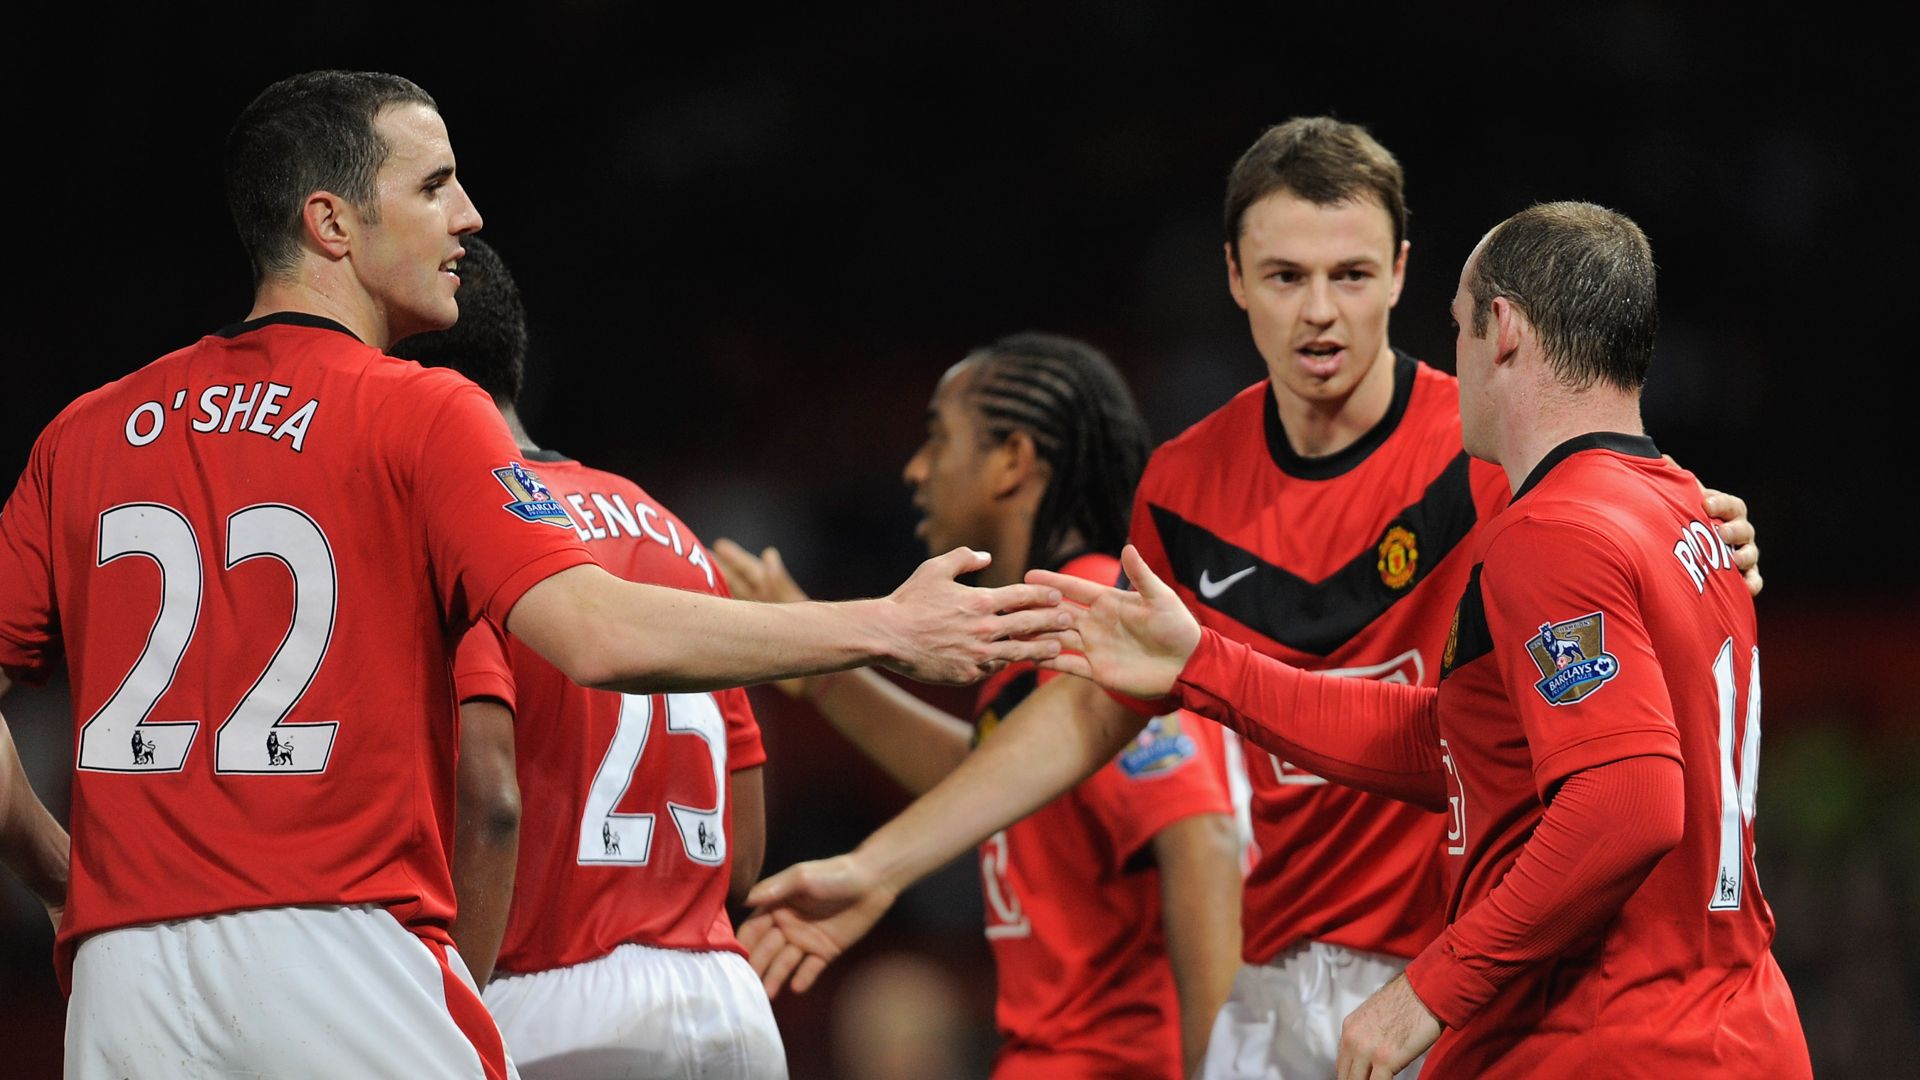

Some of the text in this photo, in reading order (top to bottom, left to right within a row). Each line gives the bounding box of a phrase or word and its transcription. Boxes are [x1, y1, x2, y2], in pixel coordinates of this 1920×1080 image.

[124, 381, 320, 454] O'SHEA
[564, 492, 715, 589] LENCIA
[76, 502, 340, 775] 22
[1548, 663, 1592, 692] BARCLAYS
